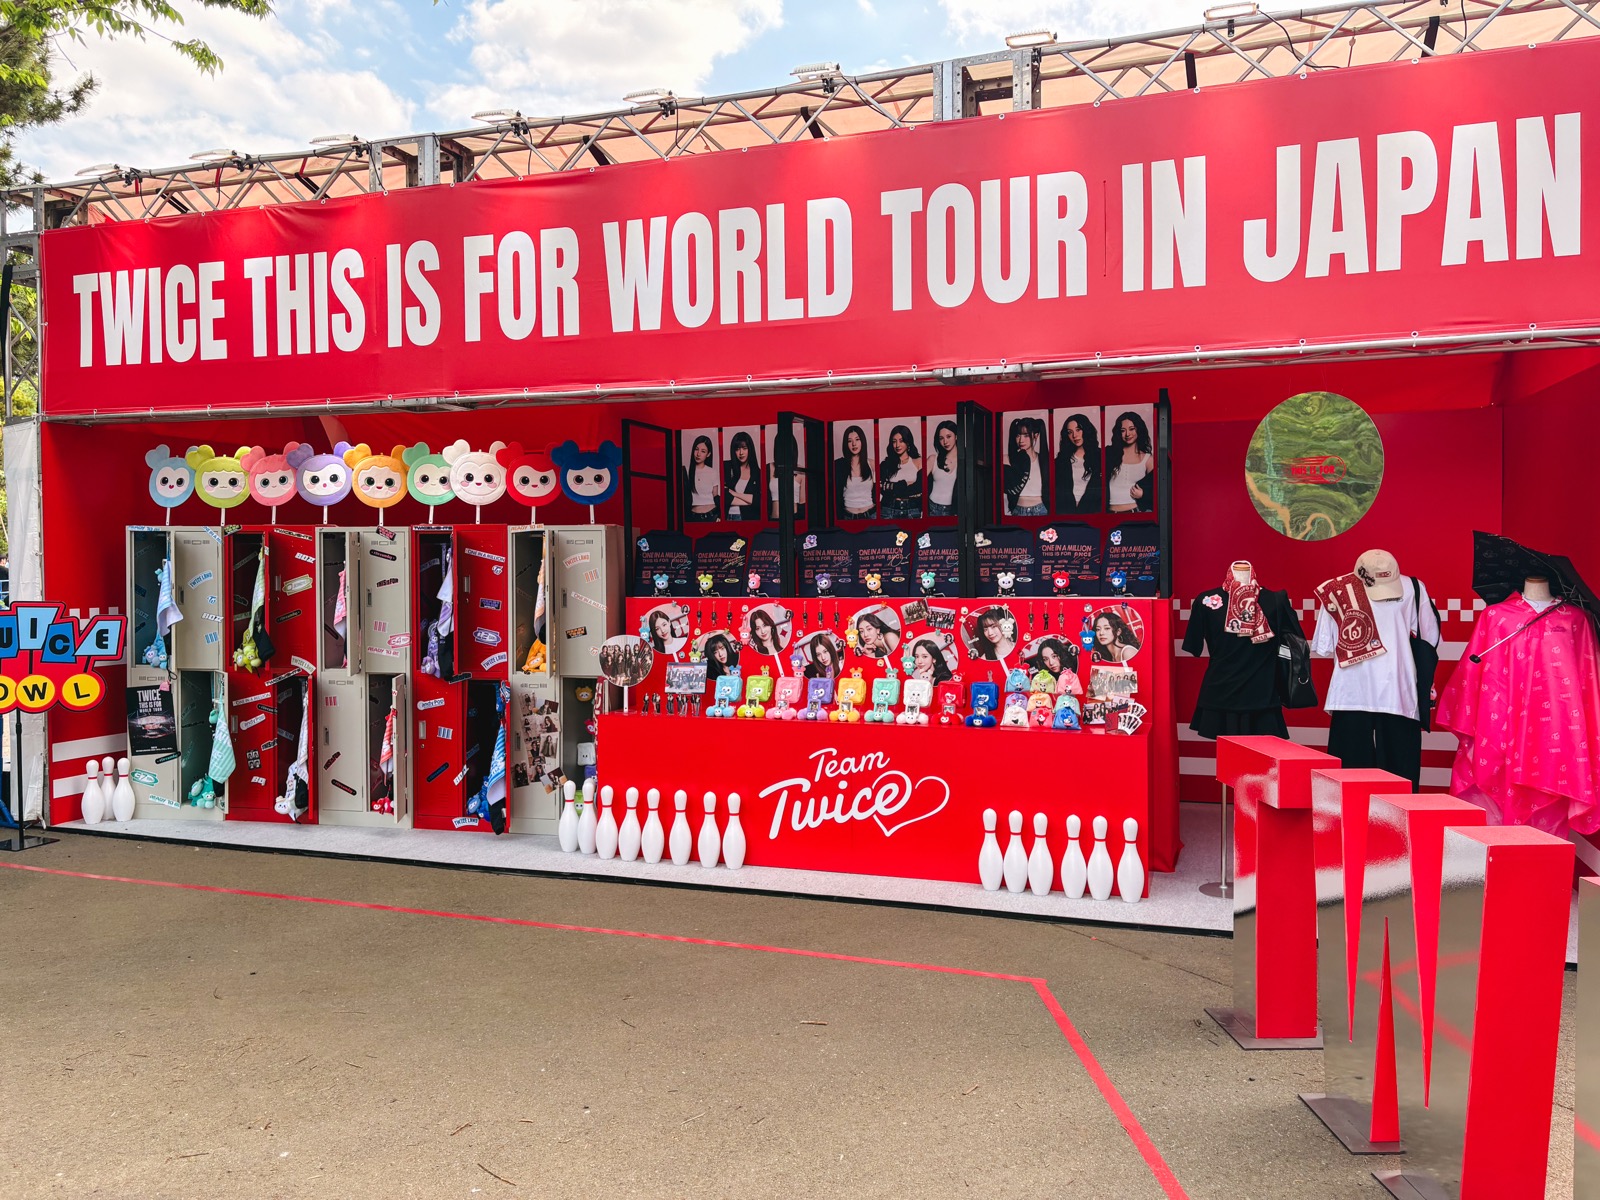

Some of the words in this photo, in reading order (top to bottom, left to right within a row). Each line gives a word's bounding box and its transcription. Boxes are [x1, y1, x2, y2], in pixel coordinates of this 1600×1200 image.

[73, 261, 228, 368] TWICE
[243, 247, 366, 357] THIS
[386, 239, 442, 348] IS
[463, 226, 580, 342] FOR
[602, 196, 853, 333] WORLD
[880, 170, 1089, 312] TOUR
[1121, 155, 1206, 292] IN
[1243, 112, 1581, 283] JAPAN
[1309, 465, 1317, 475] IS
[1319, 465, 1336, 474] FOR
[940, 548, 959, 556] MILLIO
[1067, 544, 1092, 552] MILLION
[137, 689, 161, 702] TWICE
[808, 747, 890, 782] Team
[758, 770, 912, 840] Twice
